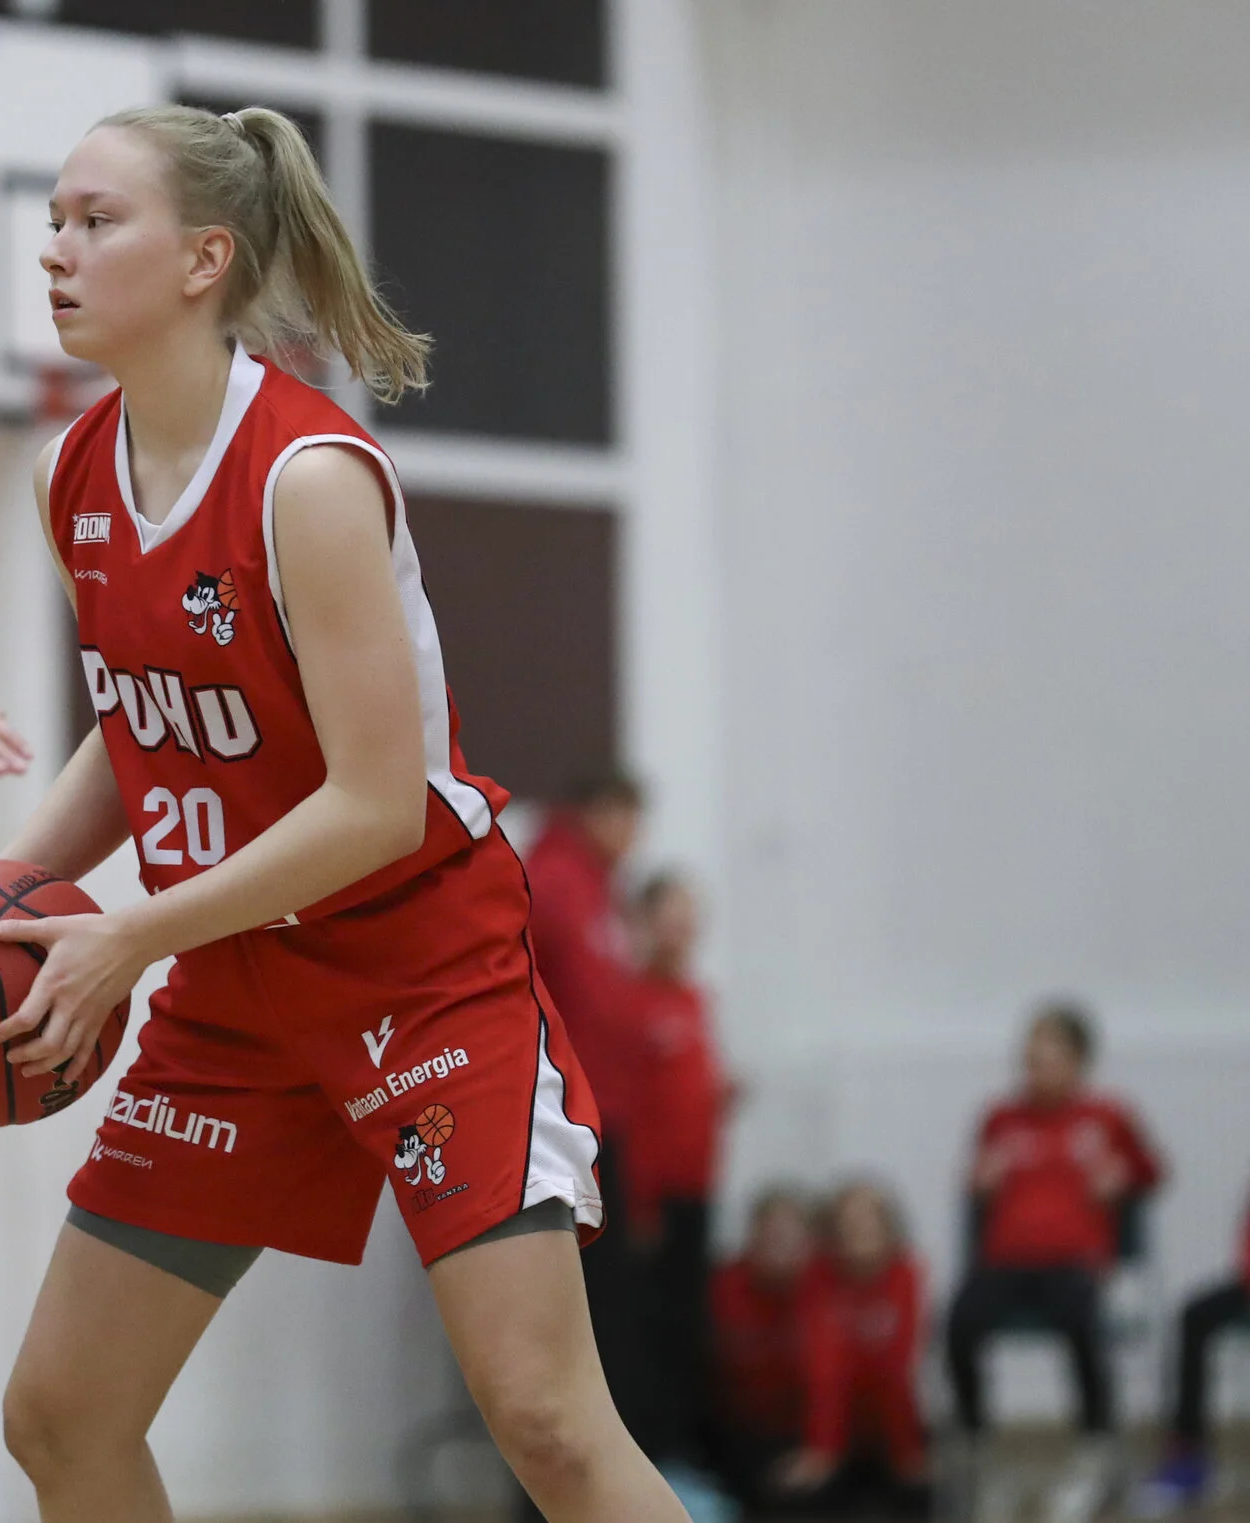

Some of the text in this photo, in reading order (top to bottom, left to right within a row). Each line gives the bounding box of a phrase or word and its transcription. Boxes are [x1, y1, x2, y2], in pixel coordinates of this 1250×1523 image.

[142, 786, 227, 866] 20
[385, 1047, 470, 1097] Energia
[435, 1182, 469, 1201] VANTAA
